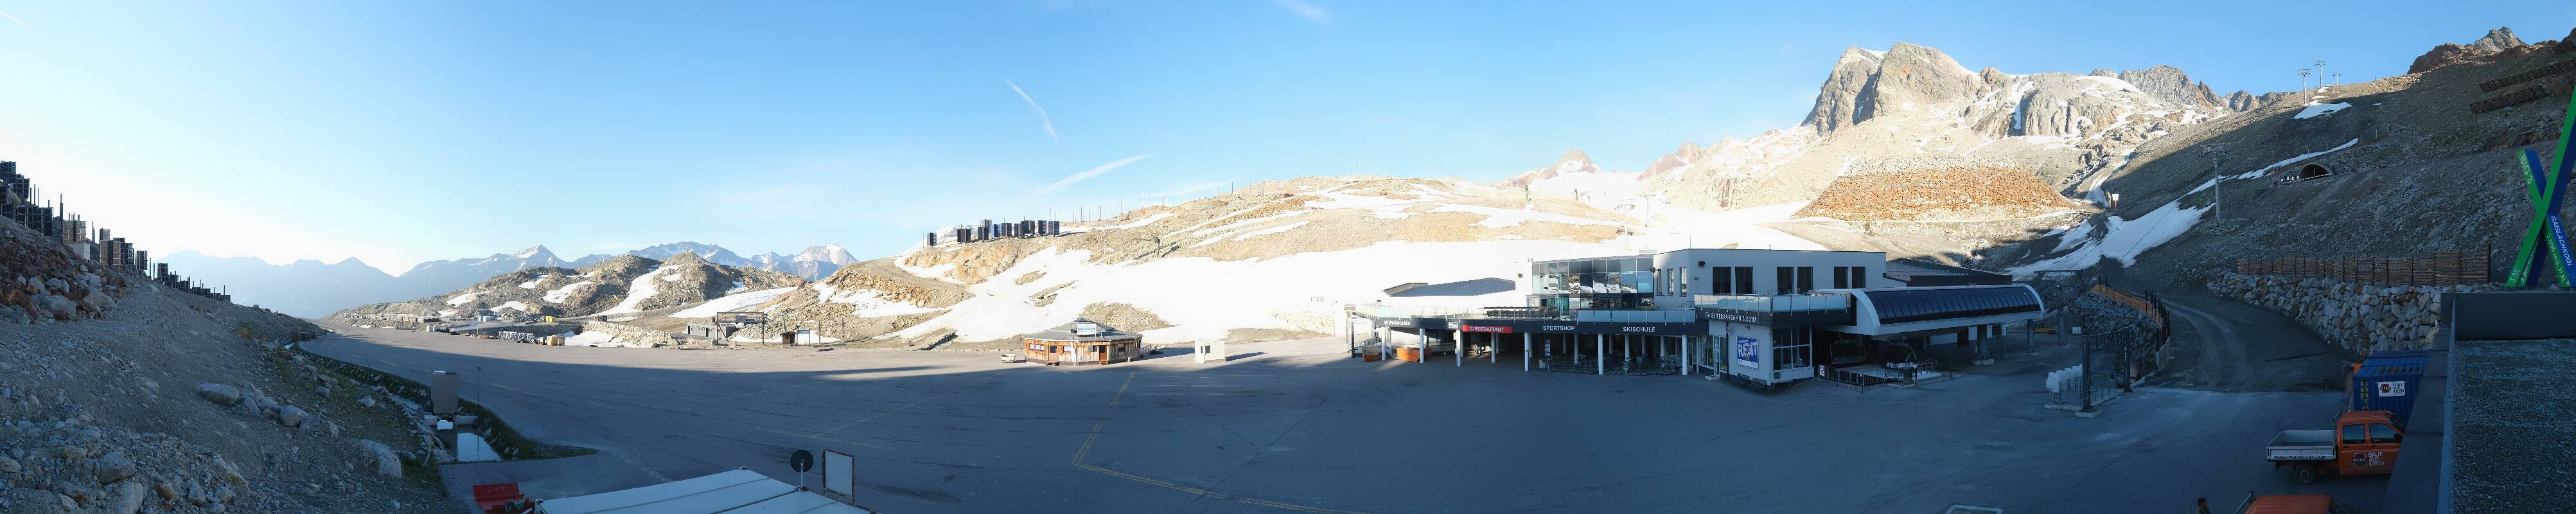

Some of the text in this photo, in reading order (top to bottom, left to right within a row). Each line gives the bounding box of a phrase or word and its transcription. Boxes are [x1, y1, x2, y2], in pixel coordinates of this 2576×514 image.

[2520, 154, 2533, 184] BIG 3
[2551, 215, 2573, 266] GAISLACHKOGL
